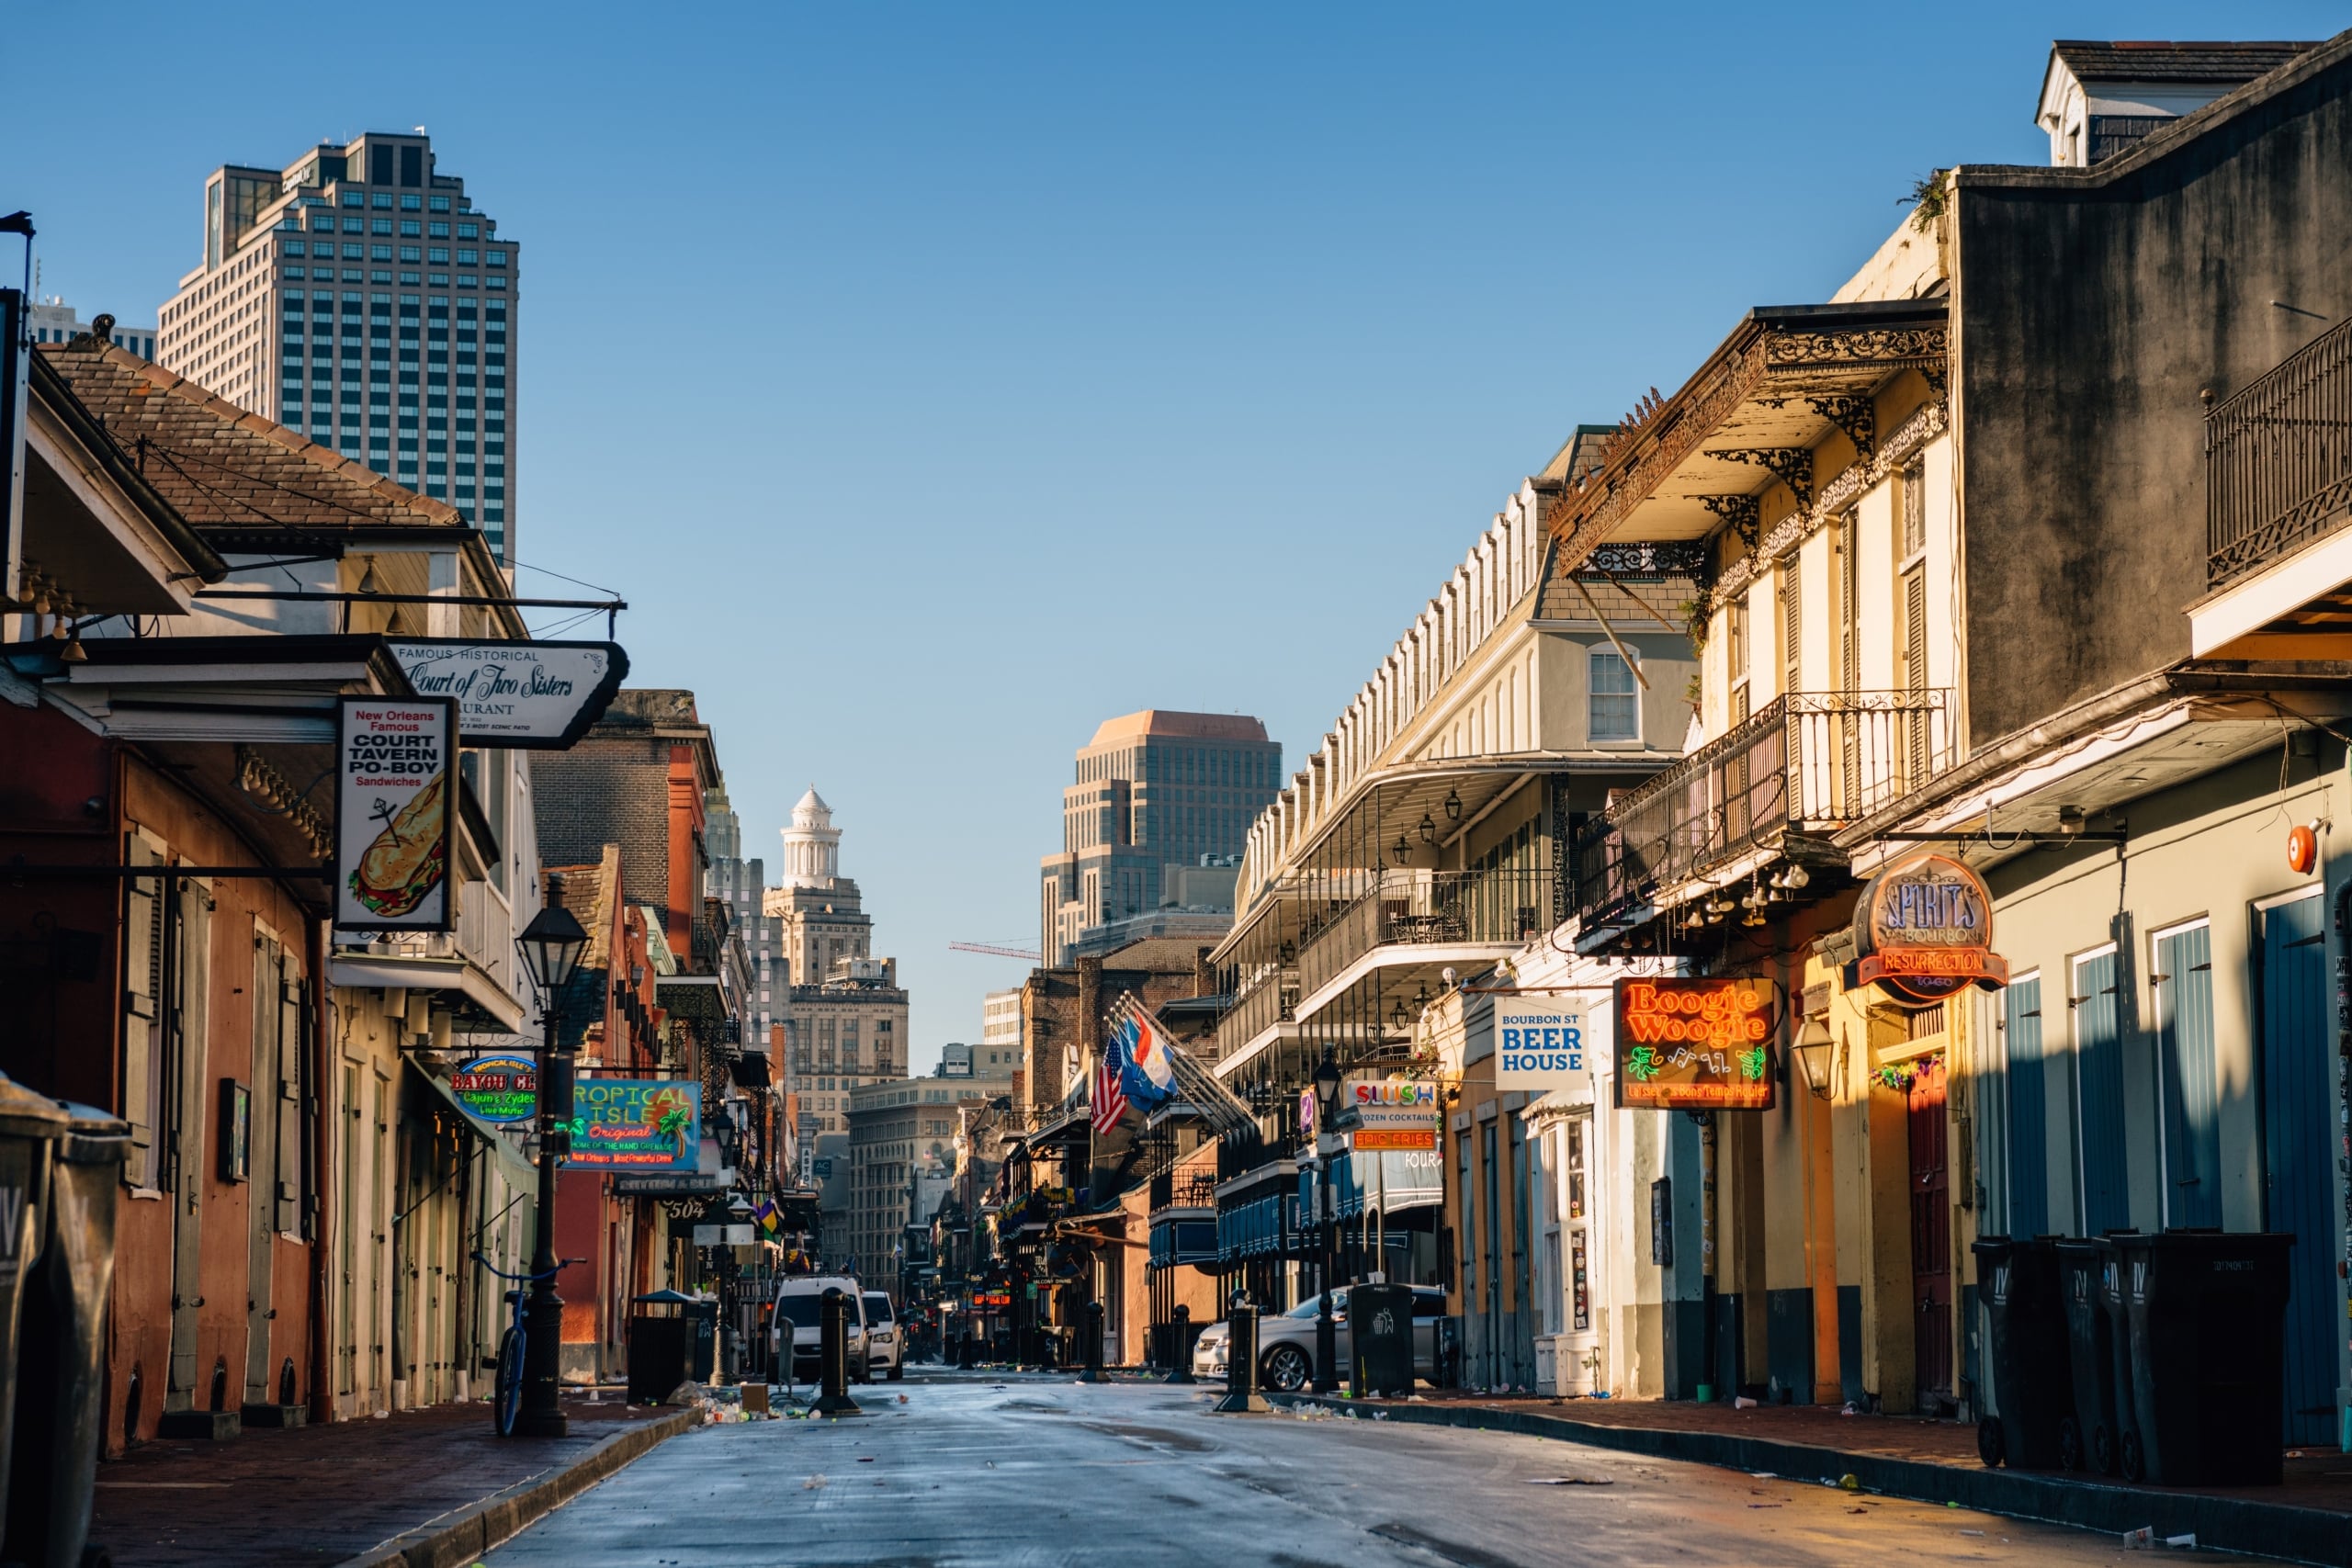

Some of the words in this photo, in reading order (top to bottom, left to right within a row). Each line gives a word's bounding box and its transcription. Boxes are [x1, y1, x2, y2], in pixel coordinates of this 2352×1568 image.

[399, 648, 453, 660] FAMOUS
[460, 650, 539, 661] HISTORICAL
[409, 661, 457, 693] Court
[455, 669, 479, 699] of
[476, 663, 518, 701] Two
[521, 664, 573, 699] Sisters
[356, 710, 383, 721] New
[386, 710, 435, 721] Orleans
[459, 703, 514, 716] URANT
[370, 721, 420, 732] Famous
[354, 734, 435, 747] COURT
[348, 748, 438, 761] TAVERN
[348, 761, 438, 774] PO-BOY
[356, 776, 422, 786] Sandwiches
[1886, 883, 1975, 929] SPIRITS
[1905, 927, 1980, 946] BOURBON
[1884, 953, 1984, 971] RESURRECTION
[1629, 983, 1759, 1021] Boogie
[1502, 1015, 1561, 1025] BOURBON
[1564, 1014, 1579, 1024] ST
[1627, 1012, 1767, 1049] Woogie
[1501, 1027, 1582, 1051] BEER
[472, 1060, 509, 1073] TROPICAL
[1502, 1054, 1582, 1072] HOUSE
[450, 1073, 509, 1091] BAYOU
[513, 1073, 537, 1091] CL
[463, 1091, 493, 1104] Cajun
[505, 1093, 536, 1106] Zydec
[572, 1087, 690, 1105] ROPICAL
[1355, 1085, 1434, 1106] SLUSH
[1679, 1084, 1702, 1098] Bons
[1702, 1084, 1735, 1099] Temps
[480, 1105, 498, 1115] Live
[499, 1106, 525, 1115] Music
[589, 1106, 657, 1125] ISLE
[1360, 1113, 1386, 1122] ROZEN
[1388, 1113, 1435, 1122] COCKTAILS
[589, 1125, 652, 1141] Original
[1355, 1134, 1388, 1146] EPIC
[1392, 1134, 1433, 1146] FRIES
[571, 1141, 591, 1149] HOME
[605, 1142, 618, 1150] THE
[619, 1142, 639, 1150] HAND
[639, 1142, 673, 1152] GRENADE
[571, 1152, 586, 1162] New
[586, 1153, 611, 1164] Orleans
[613, 1153, 629, 1164] Most
[629, 1153, 656, 1164] Powerful
[656, 1153, 674, 1164] Drink
[1405, 1153, 1436, 1168] FOUR
[670, 1201, 706, 1219] 504
